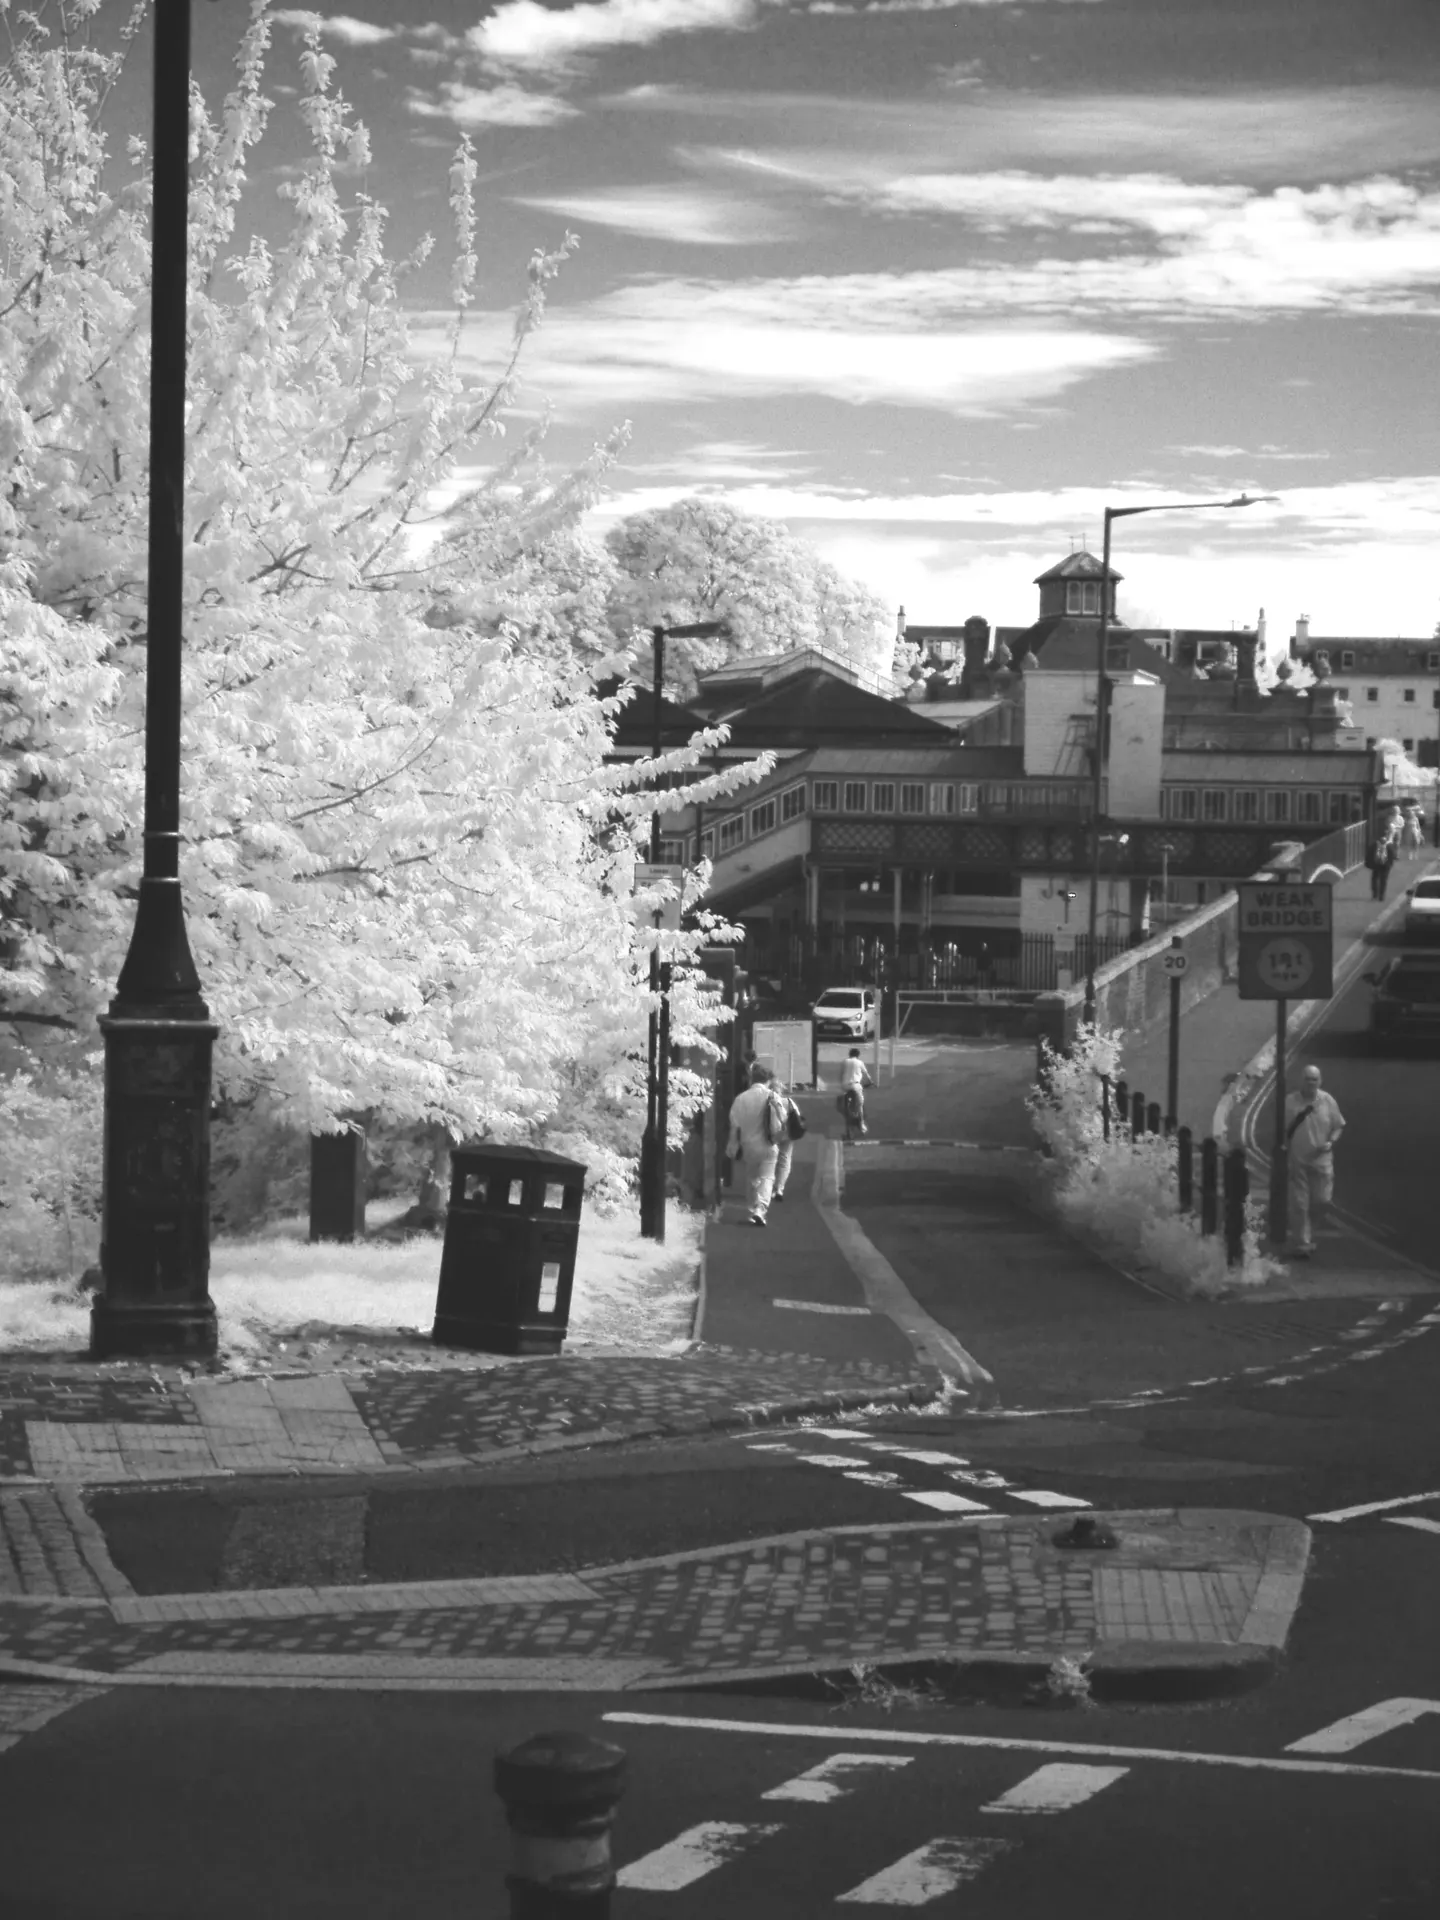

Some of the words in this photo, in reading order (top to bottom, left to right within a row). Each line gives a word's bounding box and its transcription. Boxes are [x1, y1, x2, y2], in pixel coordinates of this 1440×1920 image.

[1256, 892, 1315, 907] WEAK
[1247, 911, 1323, 926] BRIDGE
[1164, 956, 1186, 969] 20
